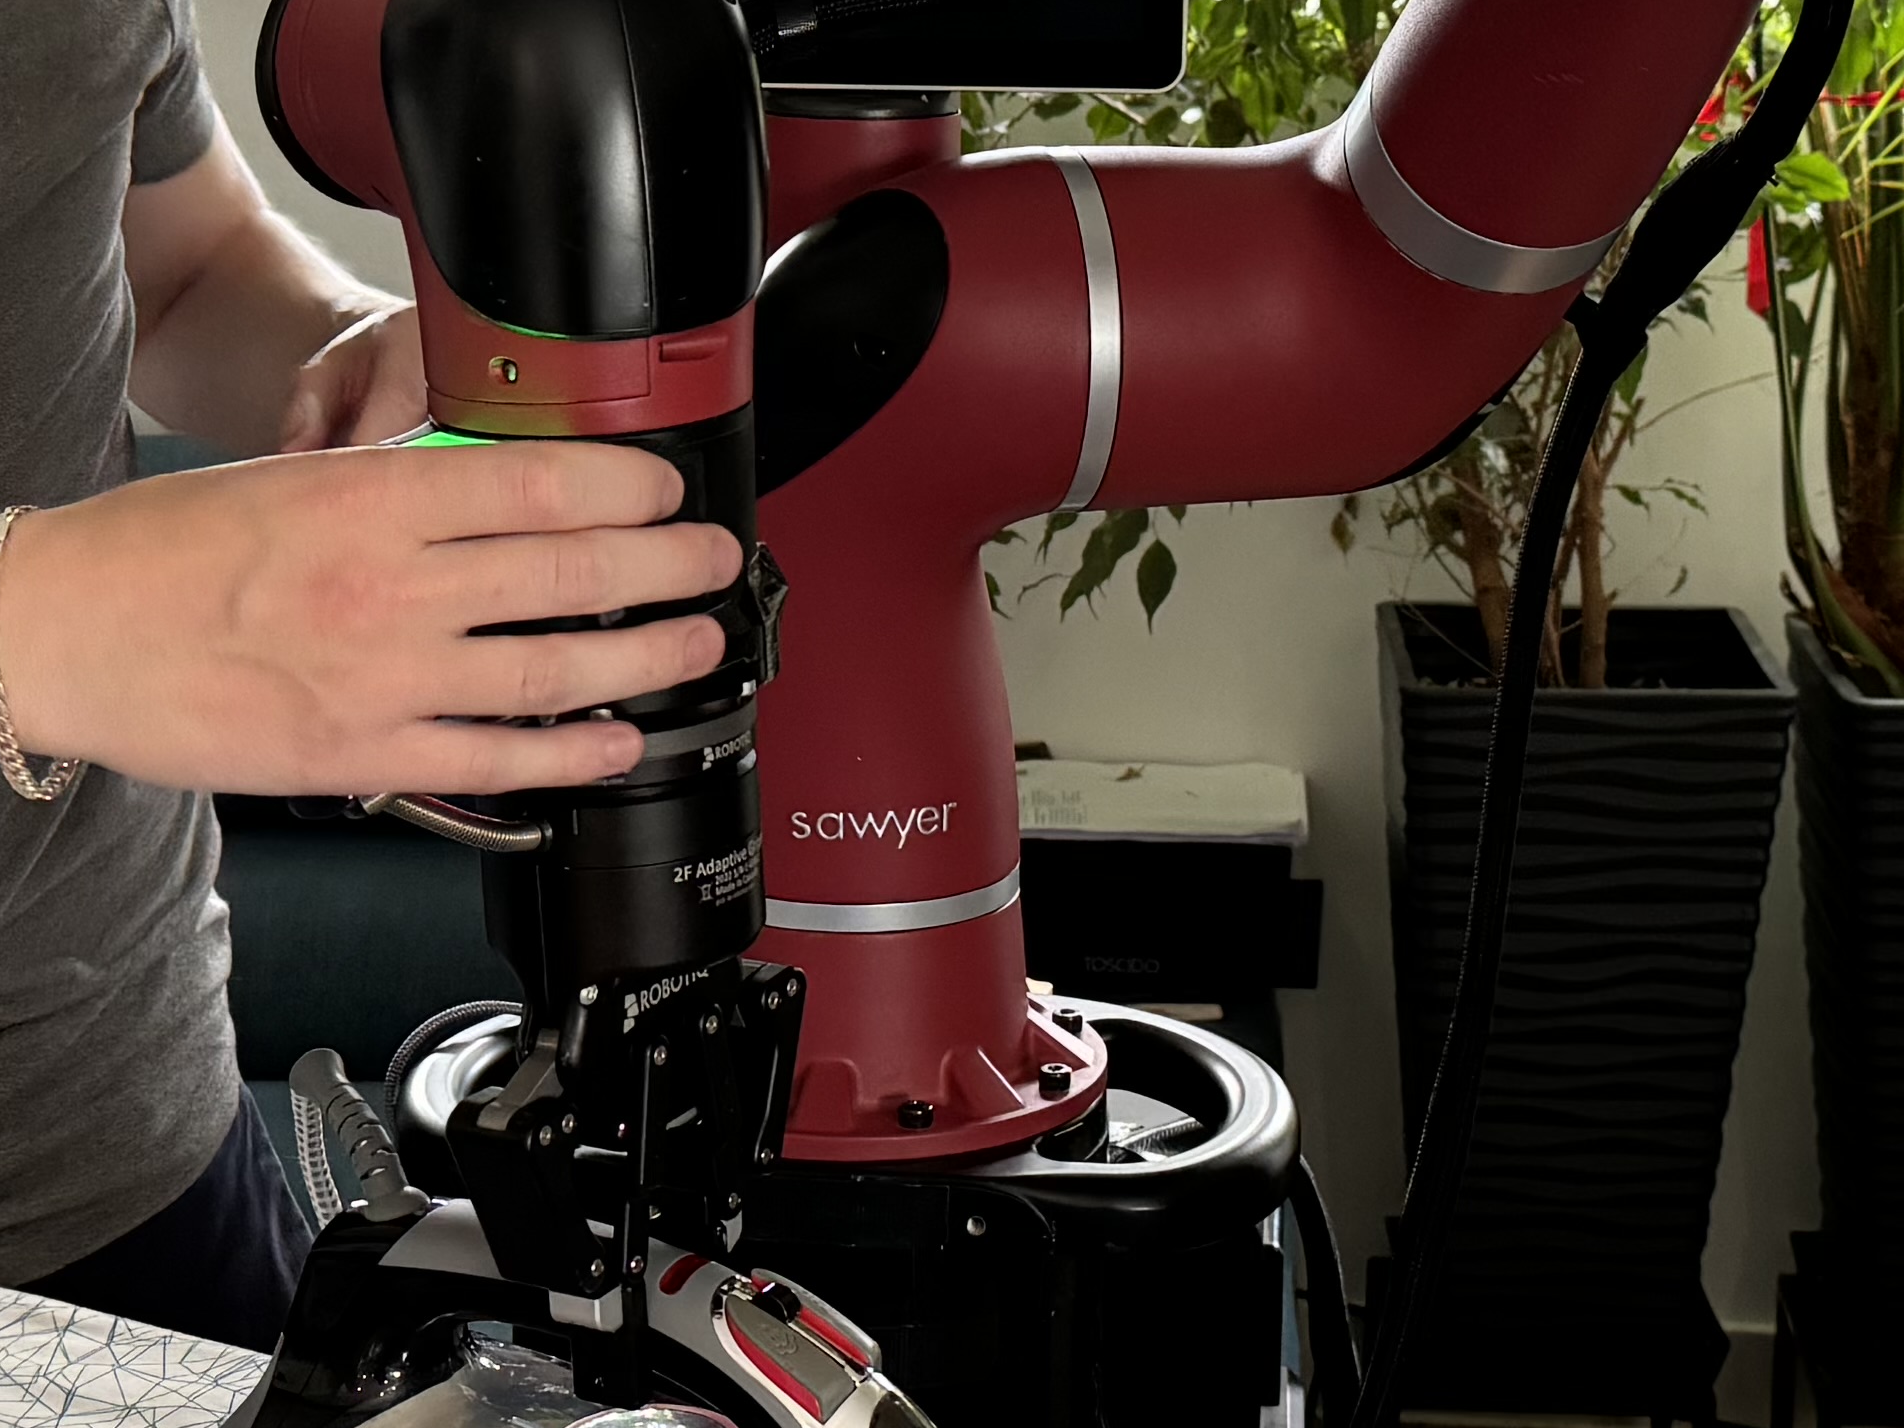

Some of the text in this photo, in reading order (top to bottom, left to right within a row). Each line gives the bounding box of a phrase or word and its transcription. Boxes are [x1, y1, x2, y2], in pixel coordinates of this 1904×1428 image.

[791, 801, 958, 850] sawyer
[673, 864, 693, 884] 2F
[696, 847, 748, 879] Adaptive
